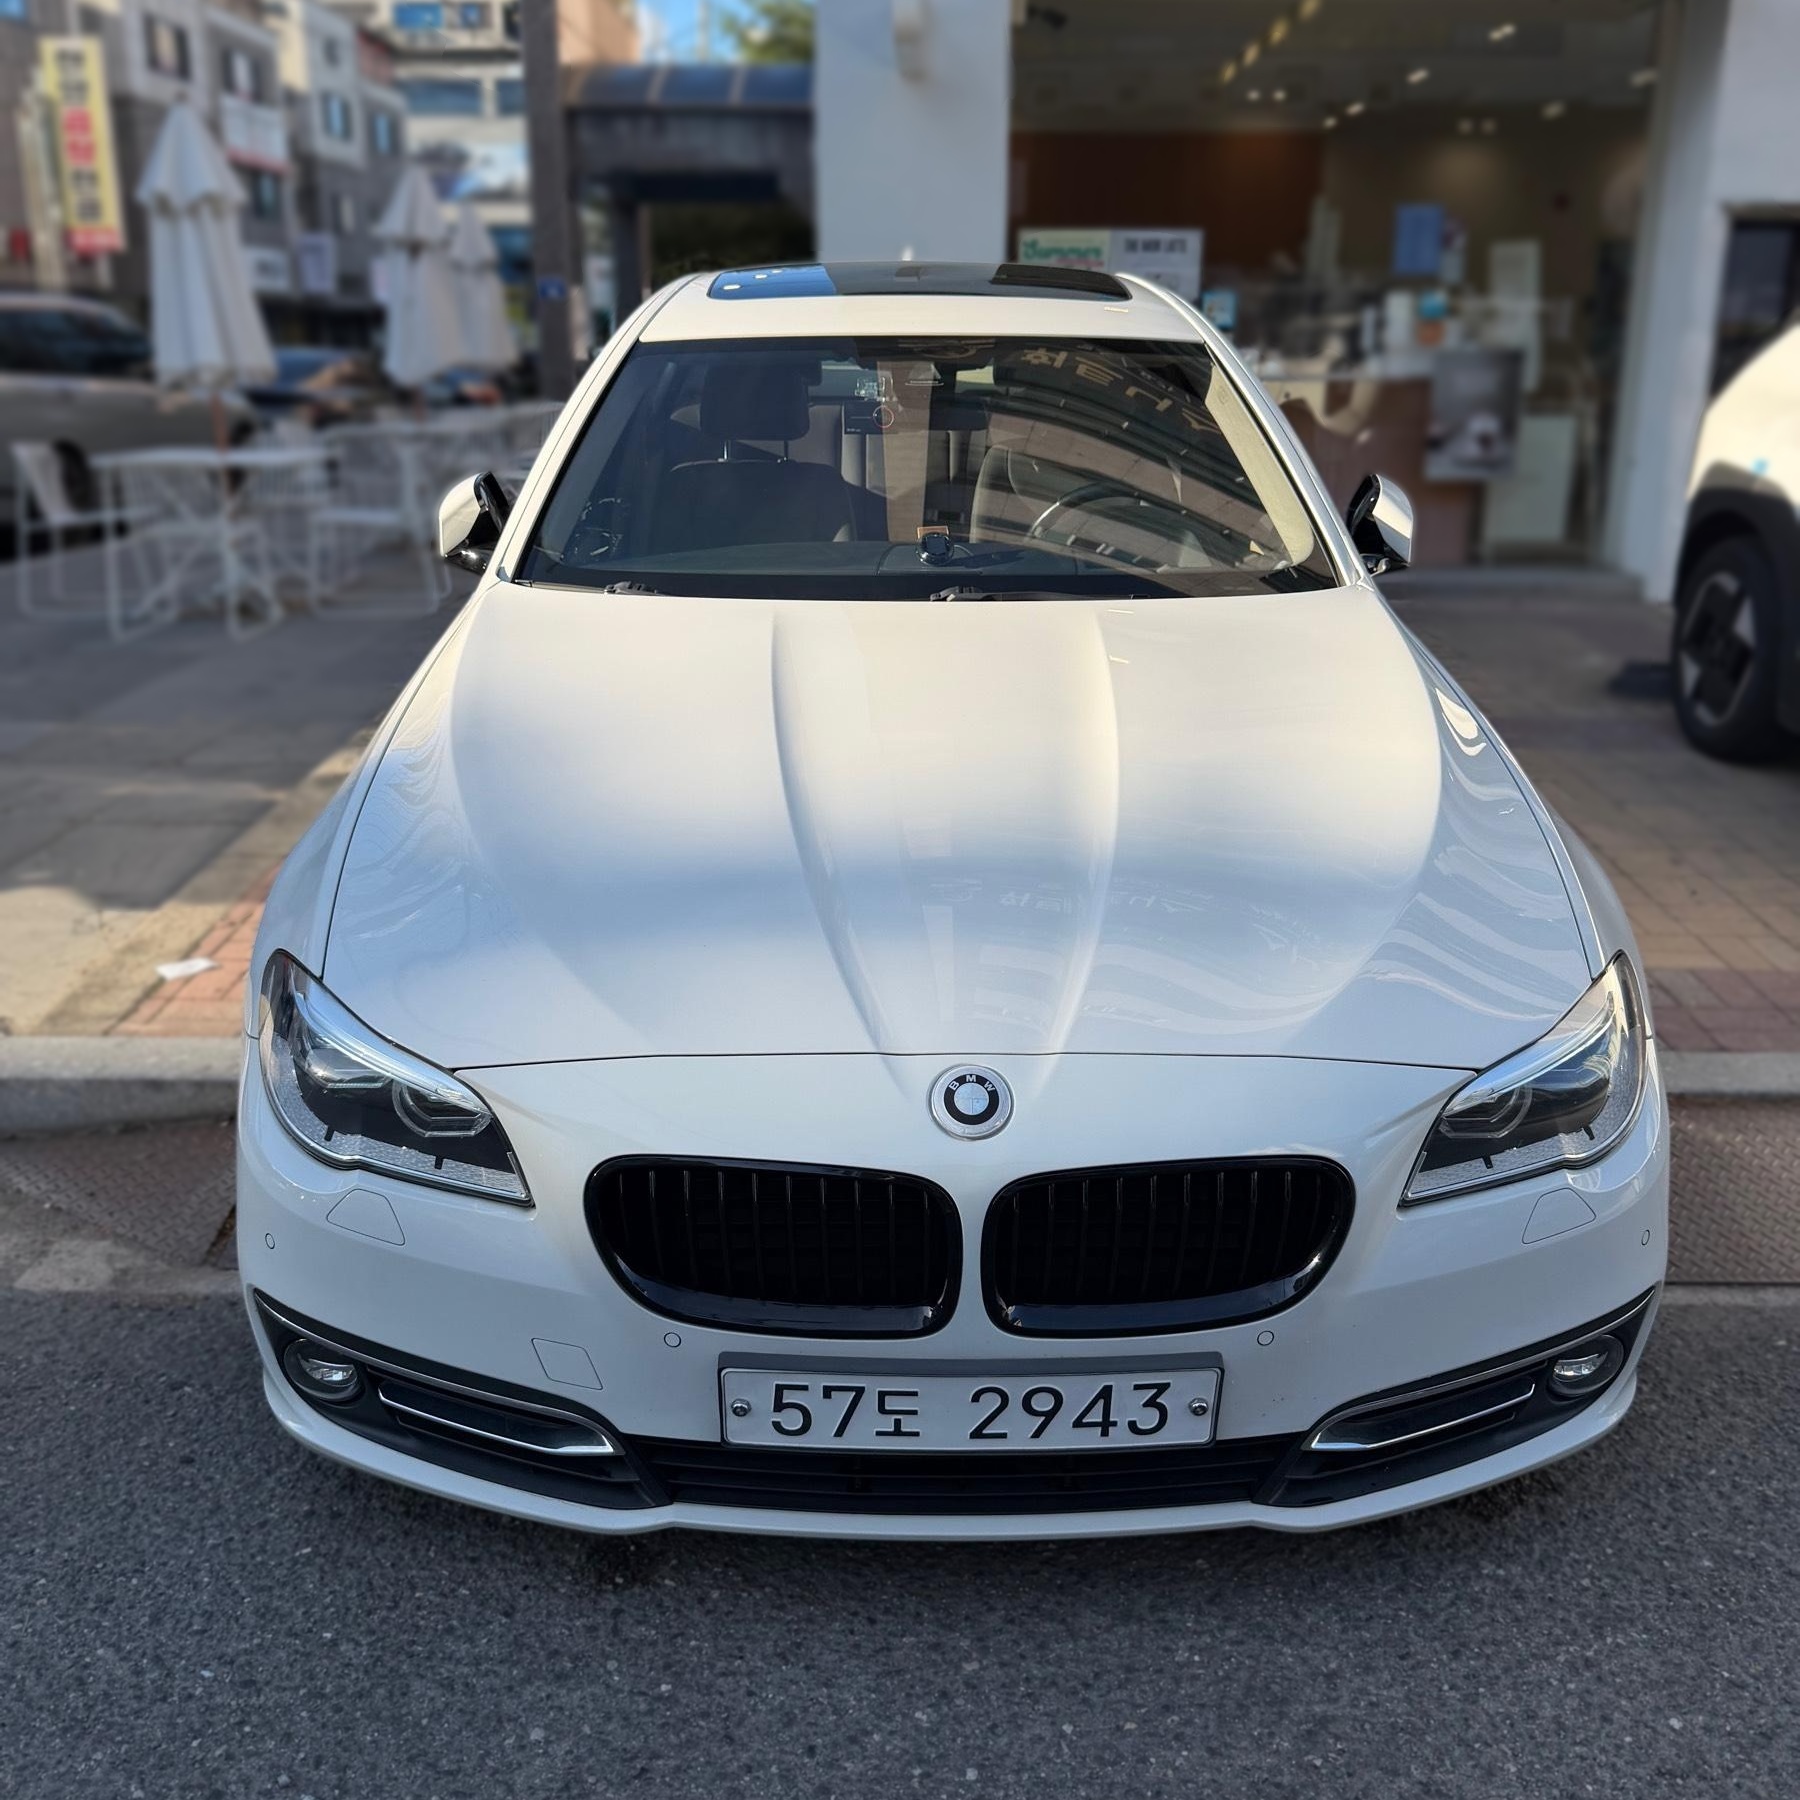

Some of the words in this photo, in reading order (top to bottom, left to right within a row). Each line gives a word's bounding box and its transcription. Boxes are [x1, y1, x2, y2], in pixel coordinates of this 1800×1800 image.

[948, 1074, 996, 1092] BMW
[770, 1382, 921, 1438] 57도
[968, 1381, 1172, 1440] 2943
